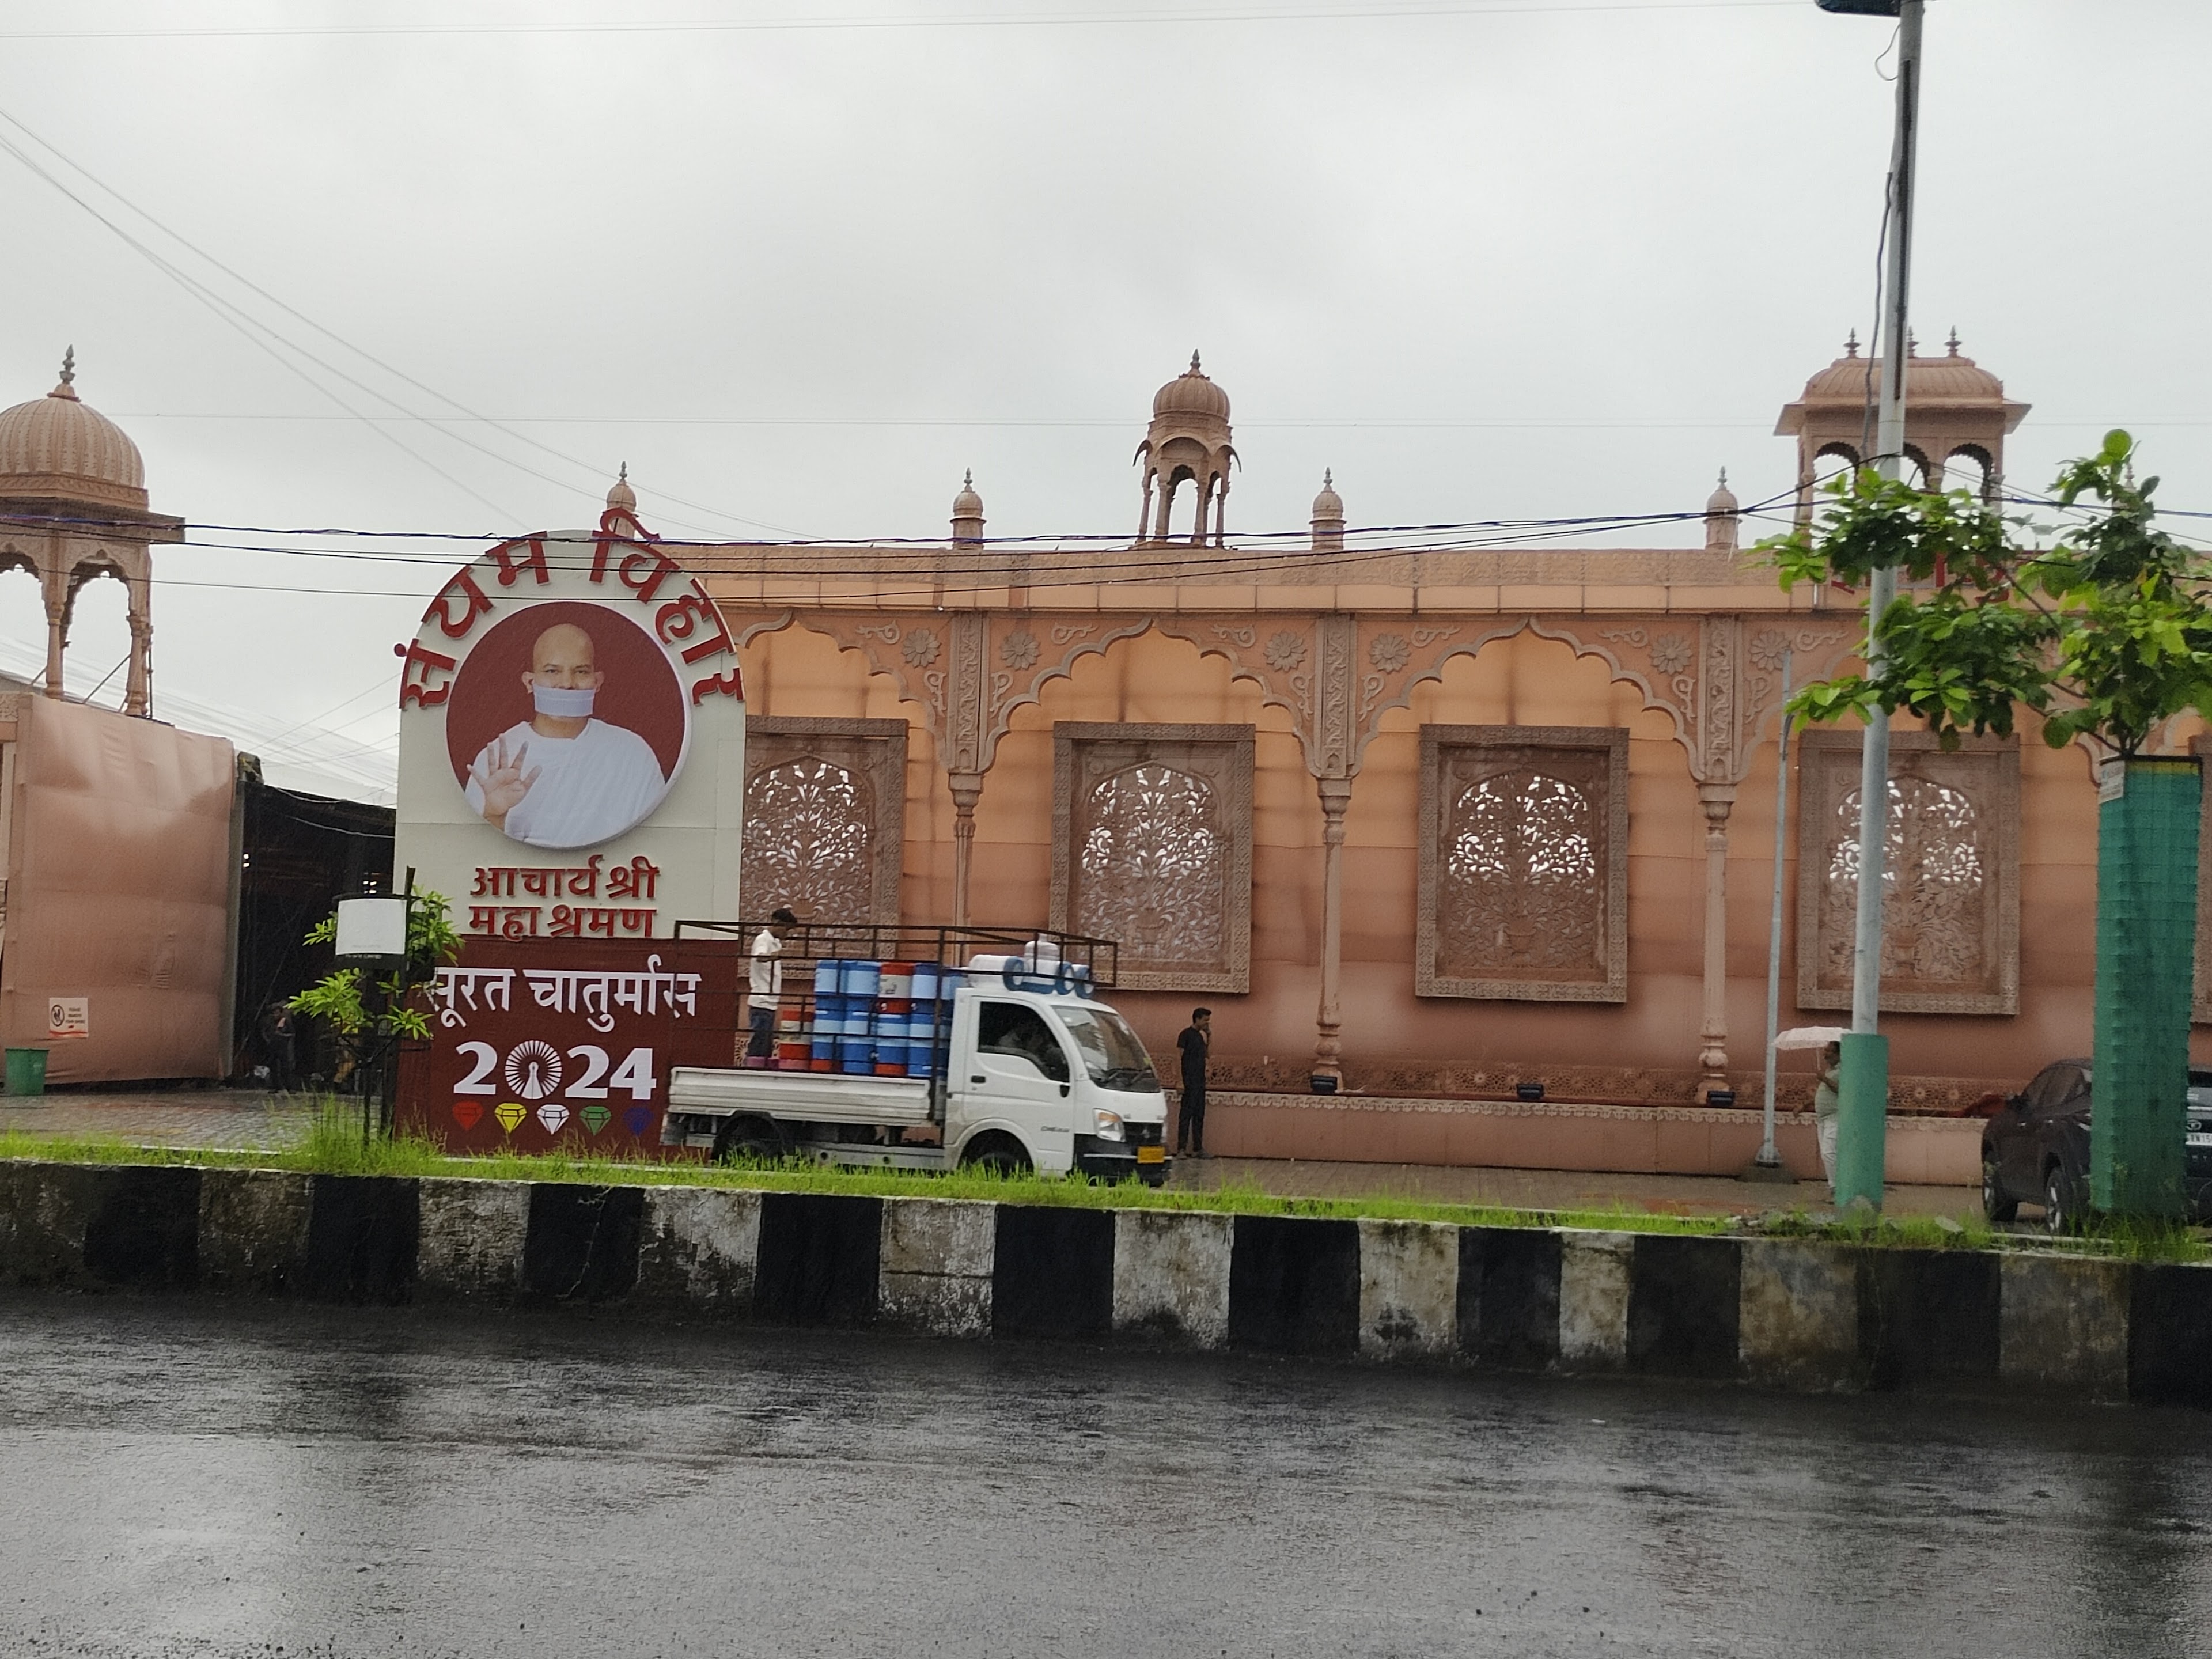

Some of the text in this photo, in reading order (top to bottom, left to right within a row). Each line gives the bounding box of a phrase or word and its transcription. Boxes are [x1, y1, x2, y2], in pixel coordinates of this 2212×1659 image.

[394, 507, 746, 709] संयम विहार
[469, 854, 660, 899] आचार्य श्री
[522, 953, 702, 1033] चातुर्मास
